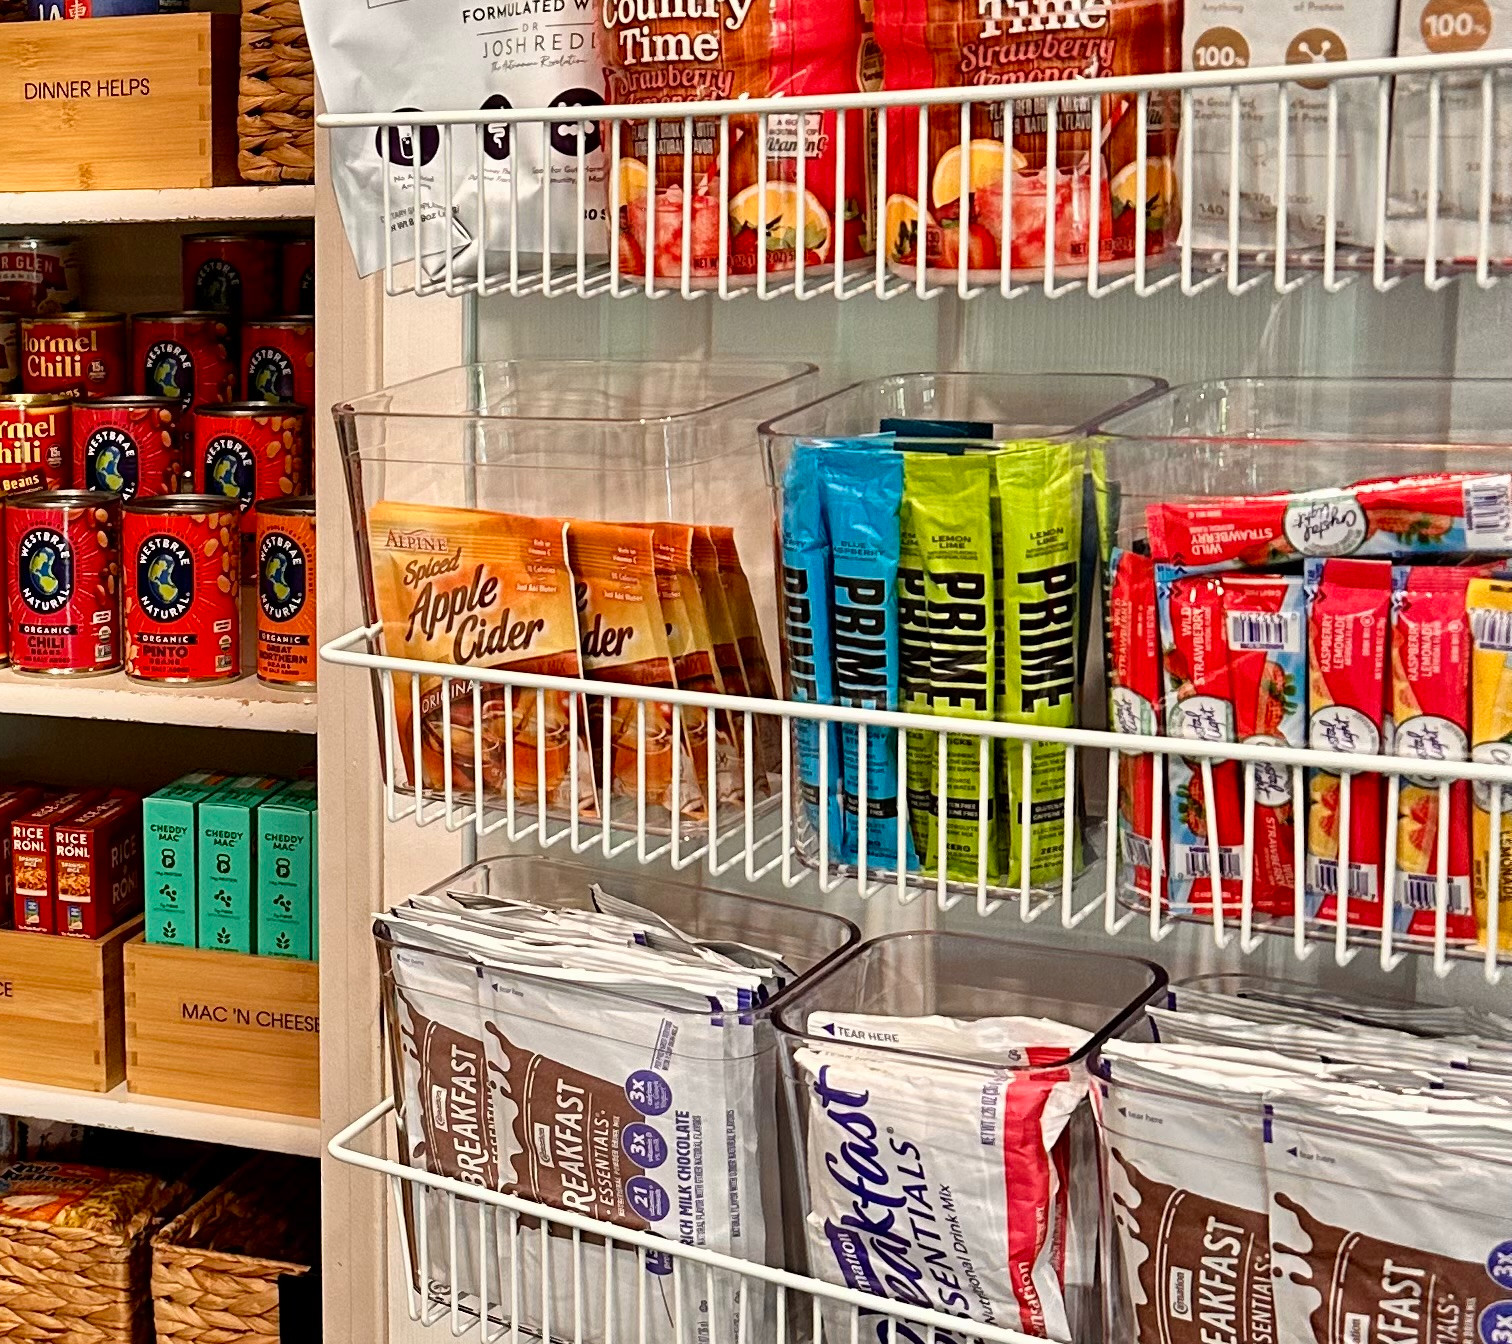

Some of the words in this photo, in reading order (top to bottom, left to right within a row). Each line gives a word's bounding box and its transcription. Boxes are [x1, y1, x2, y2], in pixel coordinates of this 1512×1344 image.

[1425, 12, 1487, 38] 100%
[482, 36, 527, 60] JOSH
[619, 27, 720, 66] Time
[960, 37, 1115, 77] Strawberry
[24, 80, 92, 100] DINNER
[96, 77, 151, 97] HELPS
[618, 66, 735, 94] Strawberry
[27, 354, 82, 378] Chili
[145, 342, 192, 371] WESTBRAE
[87, 430, 136, 458] WESTBRAE
[205, 439, 254, 468] WESTBRAE
[20, 531, 71, 560] WESTBRAE
[385, 528, 449, 554] ALPINE
[931, 535, 972, 544] LEMON
[939, 541, 967, 550] LIME
[1191, 527, 1274, 546] STRAWBERRY
[1191, 543, 1224, 556] WILD
[139, 537, 191, 567] WESTBRAE
[260, 536, 302, 567] WESTBRAE
[402, 547, 462, 587] Spiced
[21, 587, 70, 611] NATURAL
[140, 594, 190, 620] NATURAL
[261, 593, 302, 619] NATURAL
[405, 563, 499, 643] Apple
[24, 625, 71, 634] ORGANIC
[27, 636, 65, 649] CHILI
[143, 634, 189, 643] ORGANIC
[452, 606, 545, 666] Cider
[927, 570, 988, 711] PRIME
[1017, 560, 1078, 714] PRIME
[143, 645, 188, 657] PINTO
[266, 644, 293, 655] GREAT
[1320, 614, 1333, 674] RASPBERRY
[13, 826, 44, 840] RICE
[56, 831, 88, 846] RICE
[150, 823, 189, 835] CHEDDY
[205, 829, 244, 841] CHEDDY
[264, 833, 304, 844] CHEDDY
[213, 838, 236, 848] MAC
[272, 841, 296, 852] MAC
[182, 1003, 228, 1023] MAC
[675, 1109, 692, 1183] CHOCOLATE
[593, 1117, 614, 1208] ESSENTIALS
[678, 1182, 693, 1215] MILK
